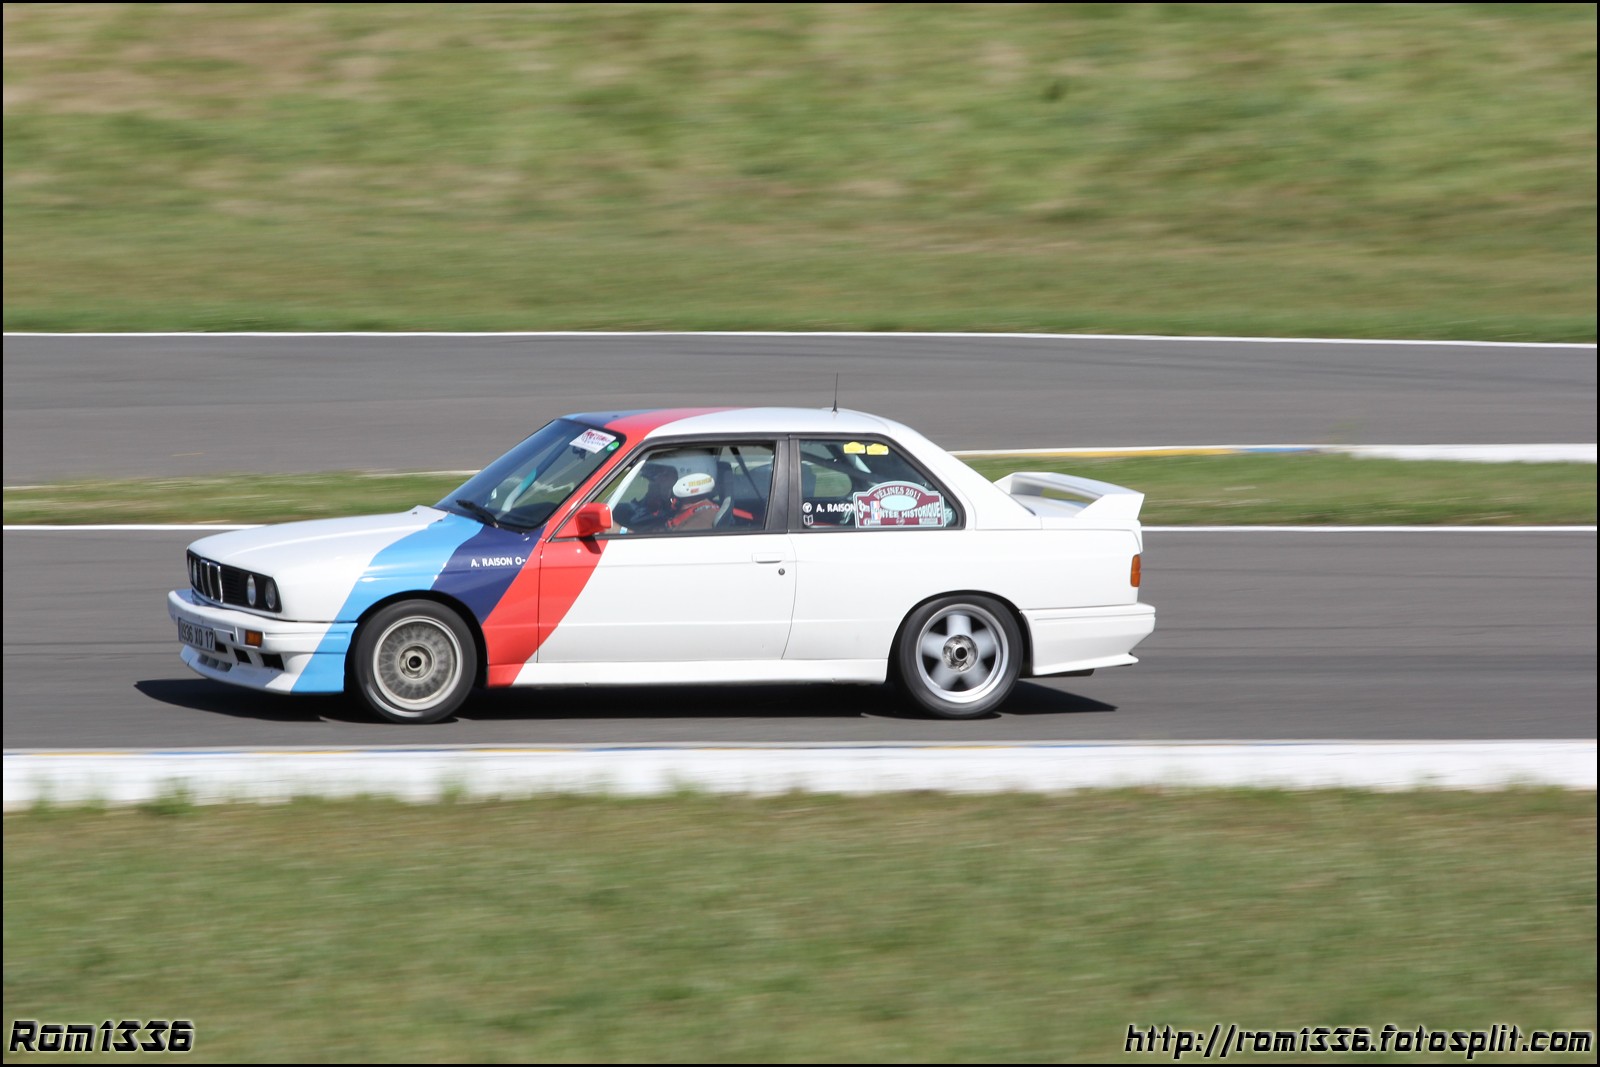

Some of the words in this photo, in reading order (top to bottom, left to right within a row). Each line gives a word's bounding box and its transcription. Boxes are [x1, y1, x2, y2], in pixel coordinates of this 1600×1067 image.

[905, 488, 922, 500] 2011
[816, 503, 825, 513] A.
[827, 503, 856, 513] RAISON
[901, 501, 941, 519] HISTORIQUE
[471, 558, 480, 568] A.
[482, 557, 512, 567] RAISON
[205, 630, 214, 649] 17
